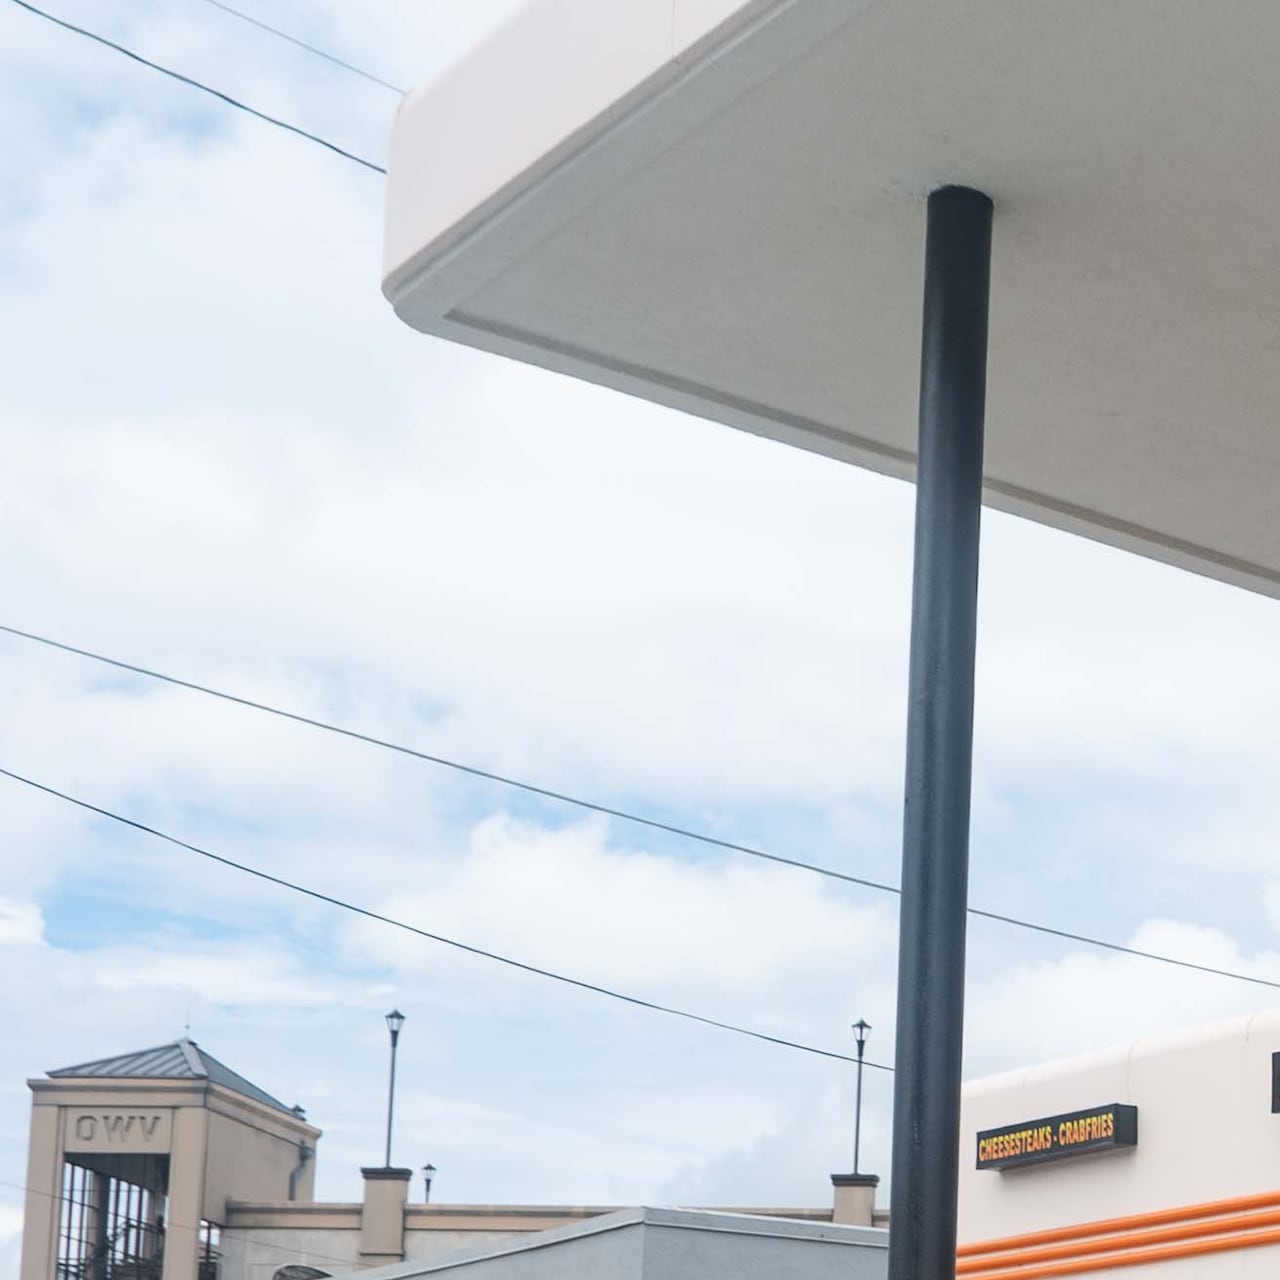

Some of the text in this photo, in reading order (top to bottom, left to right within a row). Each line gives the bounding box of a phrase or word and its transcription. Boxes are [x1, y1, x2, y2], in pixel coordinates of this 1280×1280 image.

[76, 1115, 161, 1142] OWV
[978, 1125, 1052, 1162] CHEESESTEAKS
[1059, 1113, 1114, 1146] CRABFRIES
